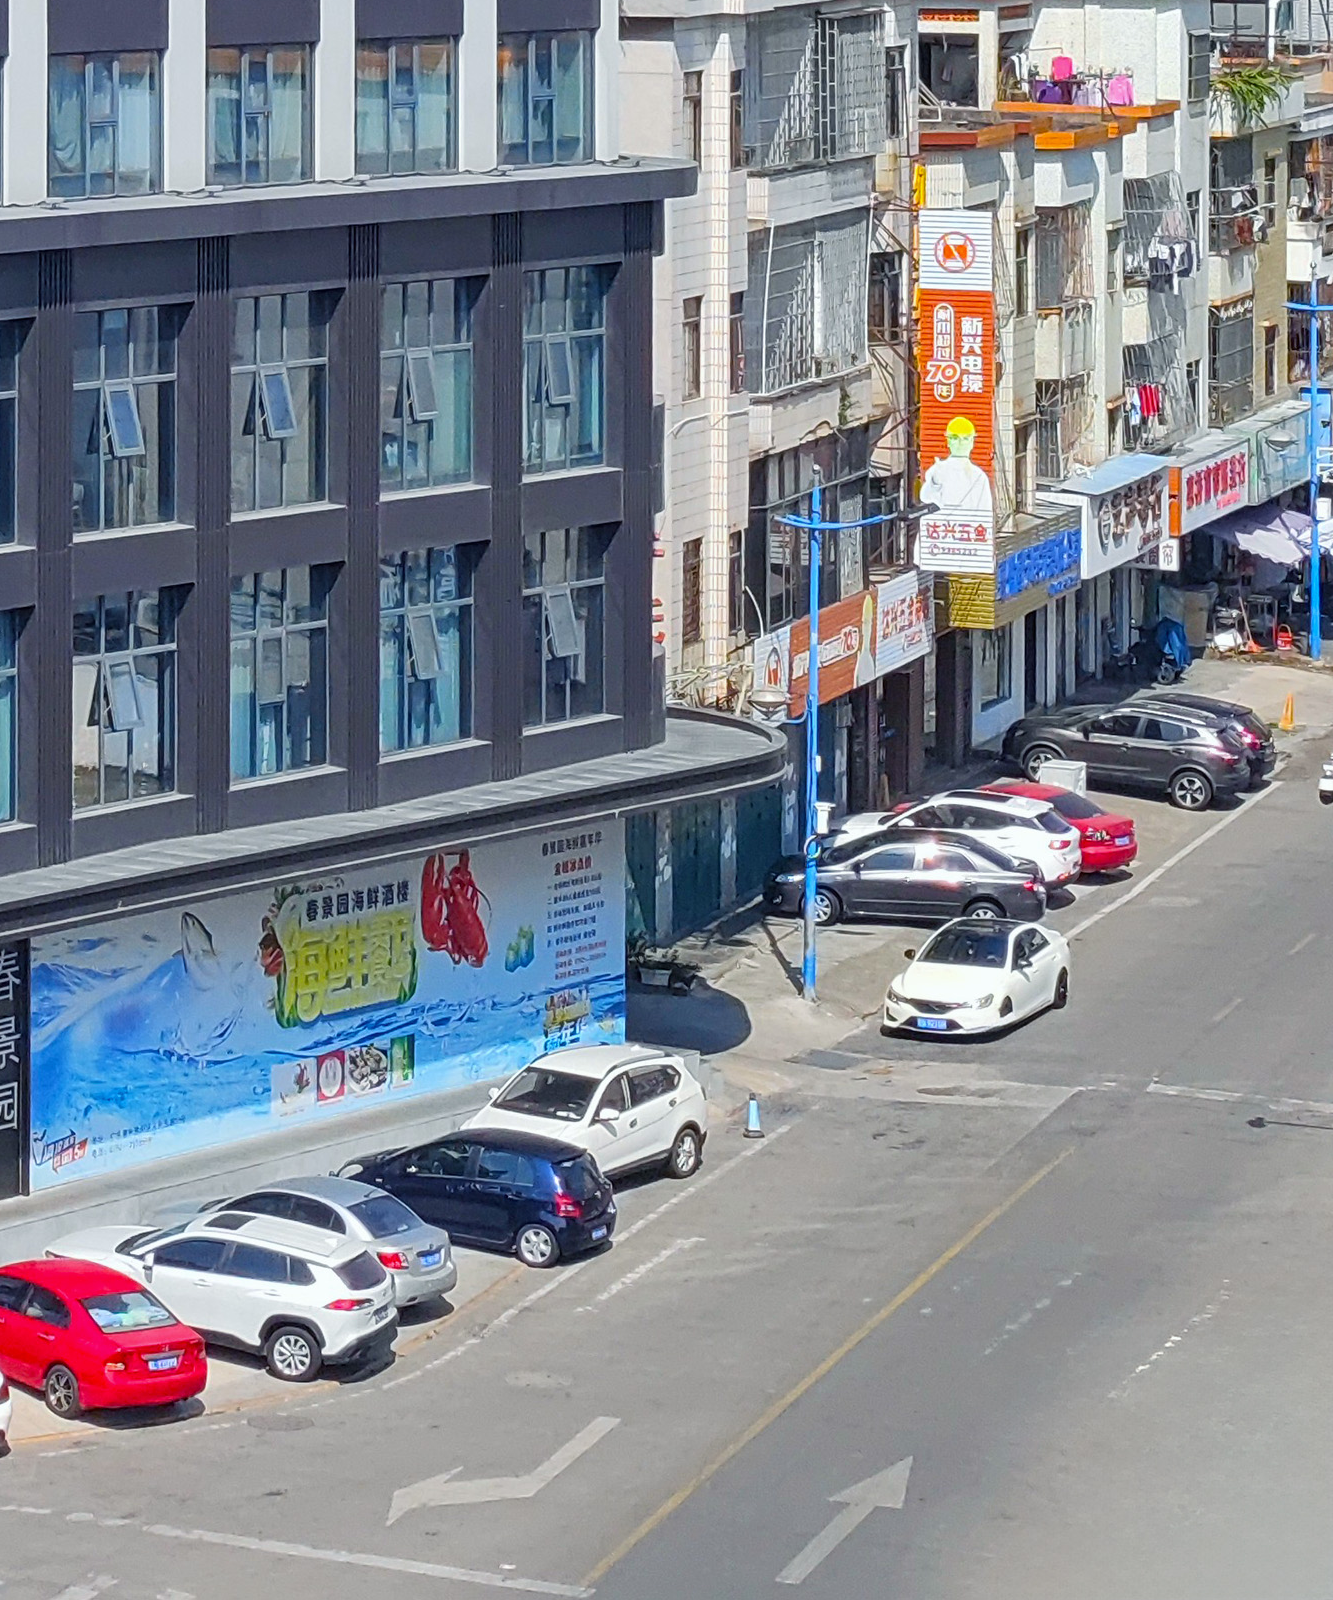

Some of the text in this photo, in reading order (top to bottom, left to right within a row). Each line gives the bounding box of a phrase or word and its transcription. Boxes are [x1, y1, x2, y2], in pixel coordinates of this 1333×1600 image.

[960, 316, 984, 393] 新兴电缆
[305, 879, 410, 923] 春景园海鲜酒楼
